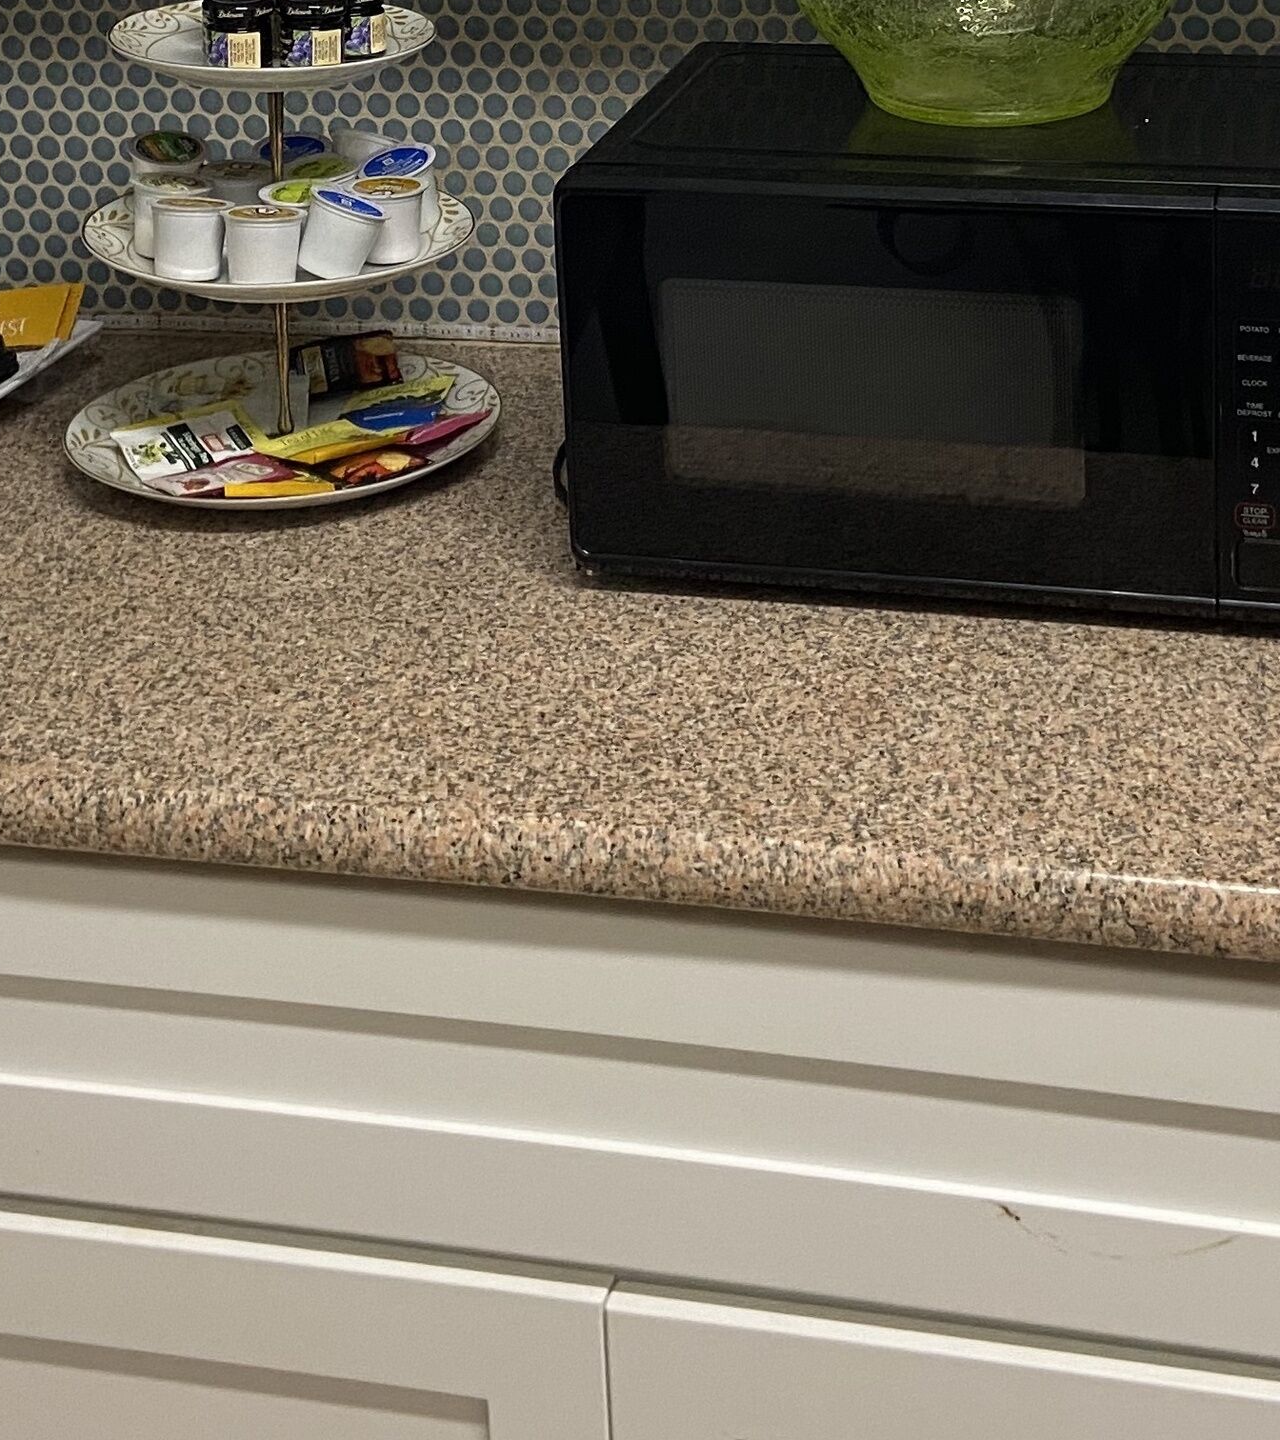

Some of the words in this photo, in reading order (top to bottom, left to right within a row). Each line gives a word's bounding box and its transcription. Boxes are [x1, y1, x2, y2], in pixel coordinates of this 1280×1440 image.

[1239, 325, 1270, 334] POTATO
[1241, 379, 1269, 387] CLOCK
[1251, 430, 1258, 443] 1
[1250, 456, 1260, 469] 4
[1250, 483, 1260, 495] 7
